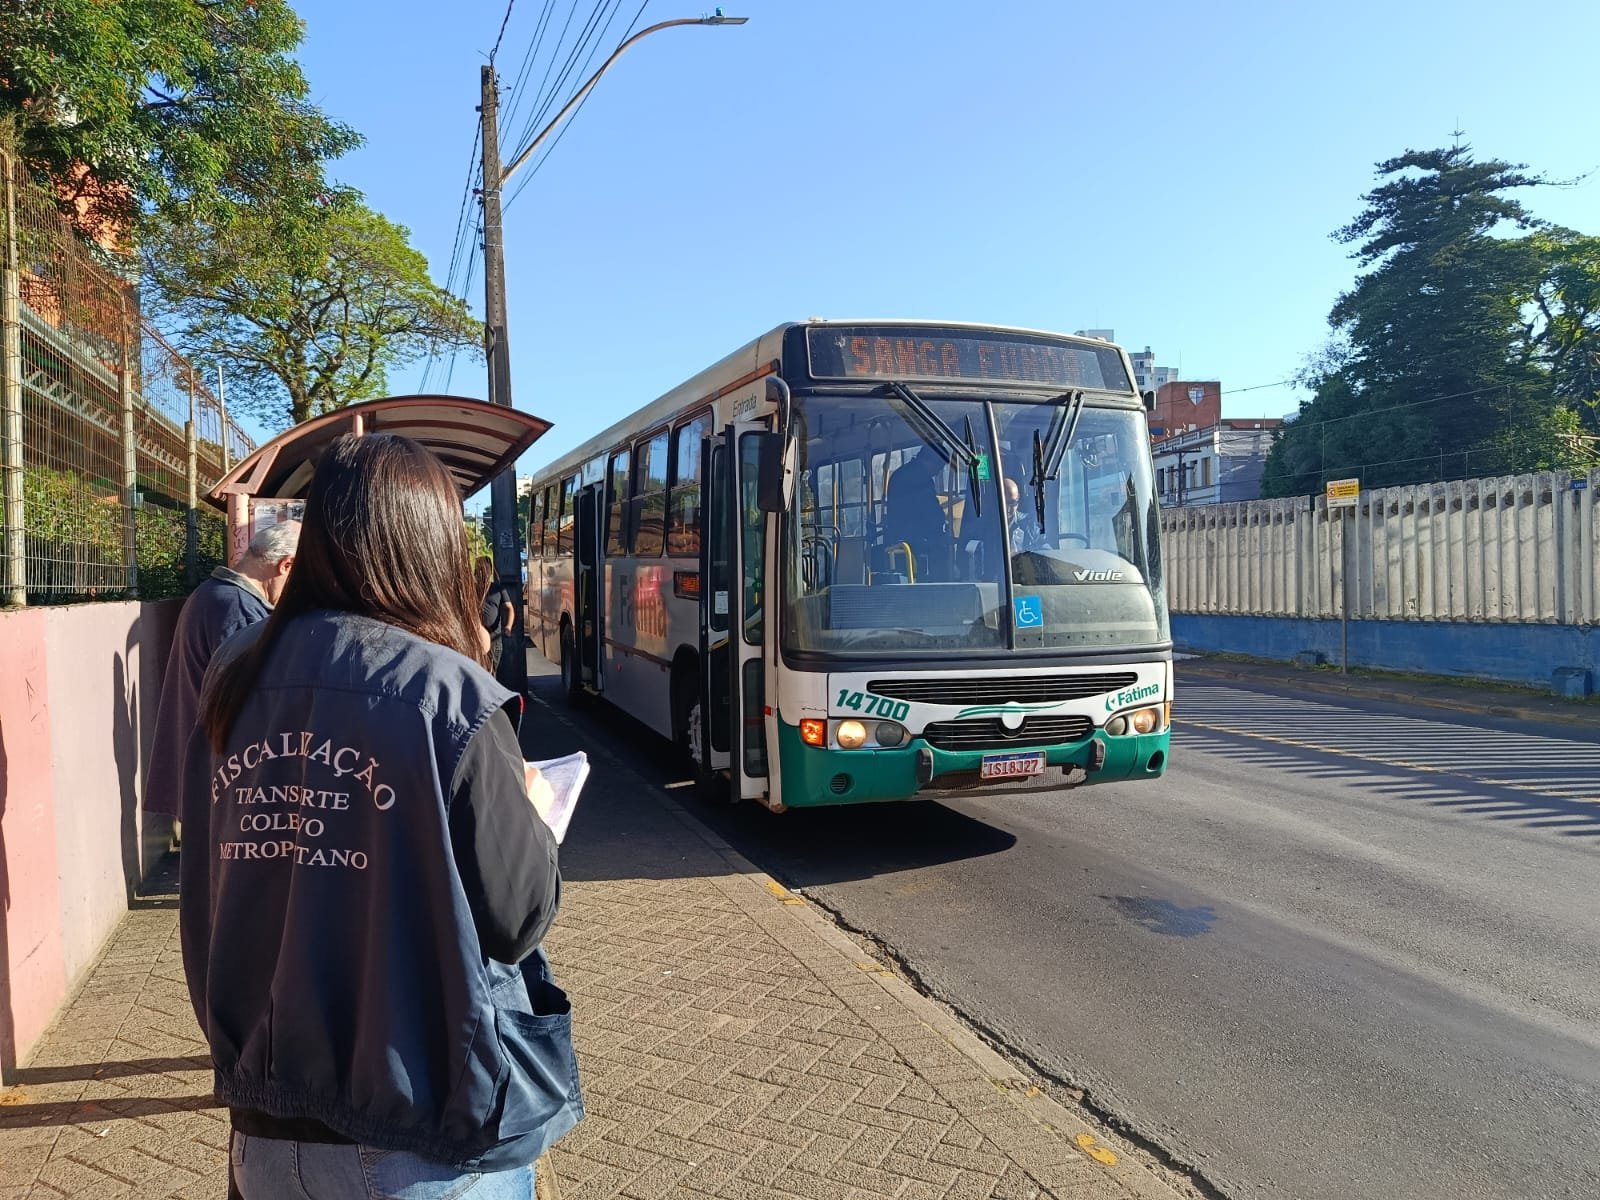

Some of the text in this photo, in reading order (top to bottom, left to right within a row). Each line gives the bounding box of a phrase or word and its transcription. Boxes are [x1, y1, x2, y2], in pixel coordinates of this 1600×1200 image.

[1072, 569, 1124, 582] Viale
[1117, 683, 1160, 706] Fátima
[836, 688, 911, 722] 14700
[988, 759, 1039, 777] ISI8J27
